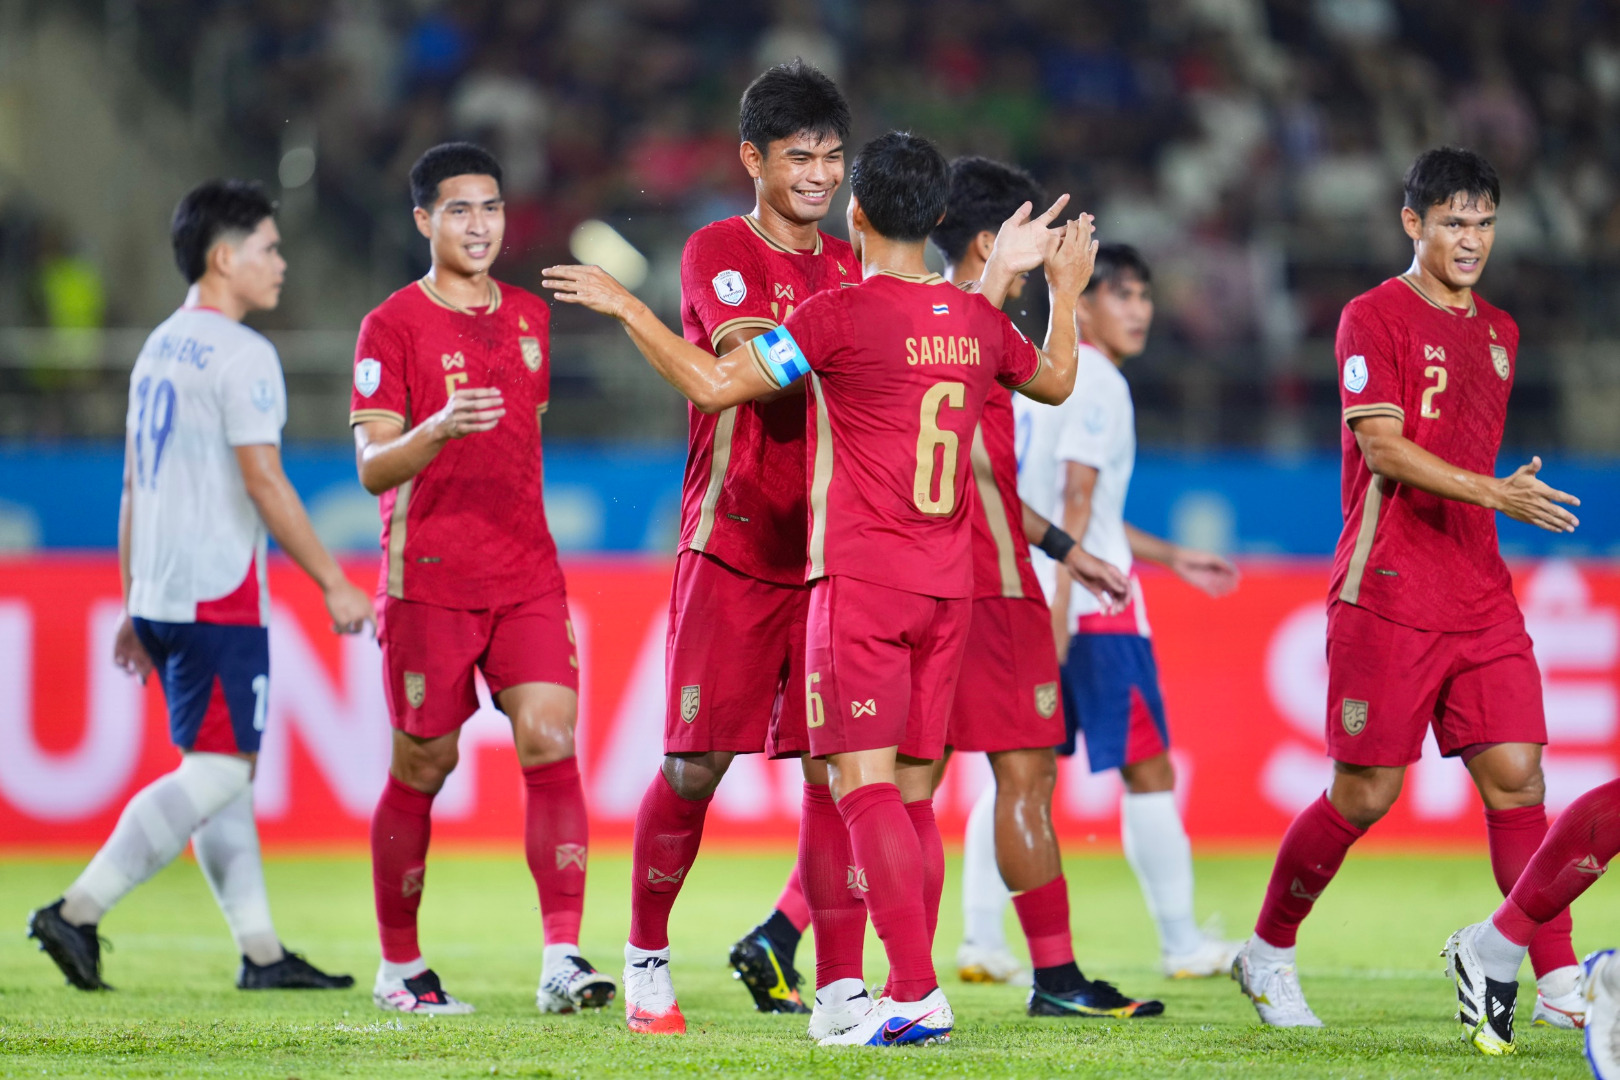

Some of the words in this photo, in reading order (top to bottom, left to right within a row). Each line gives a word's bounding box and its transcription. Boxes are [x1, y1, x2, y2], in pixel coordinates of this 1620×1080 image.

[905, 335, 981, 366] SARACH
[1420, 365, 1448, 419] 2
[134, 375, 177, 491] 19
[913, 381, 965, 516] 6
[806, 671, 825, 728] 6
